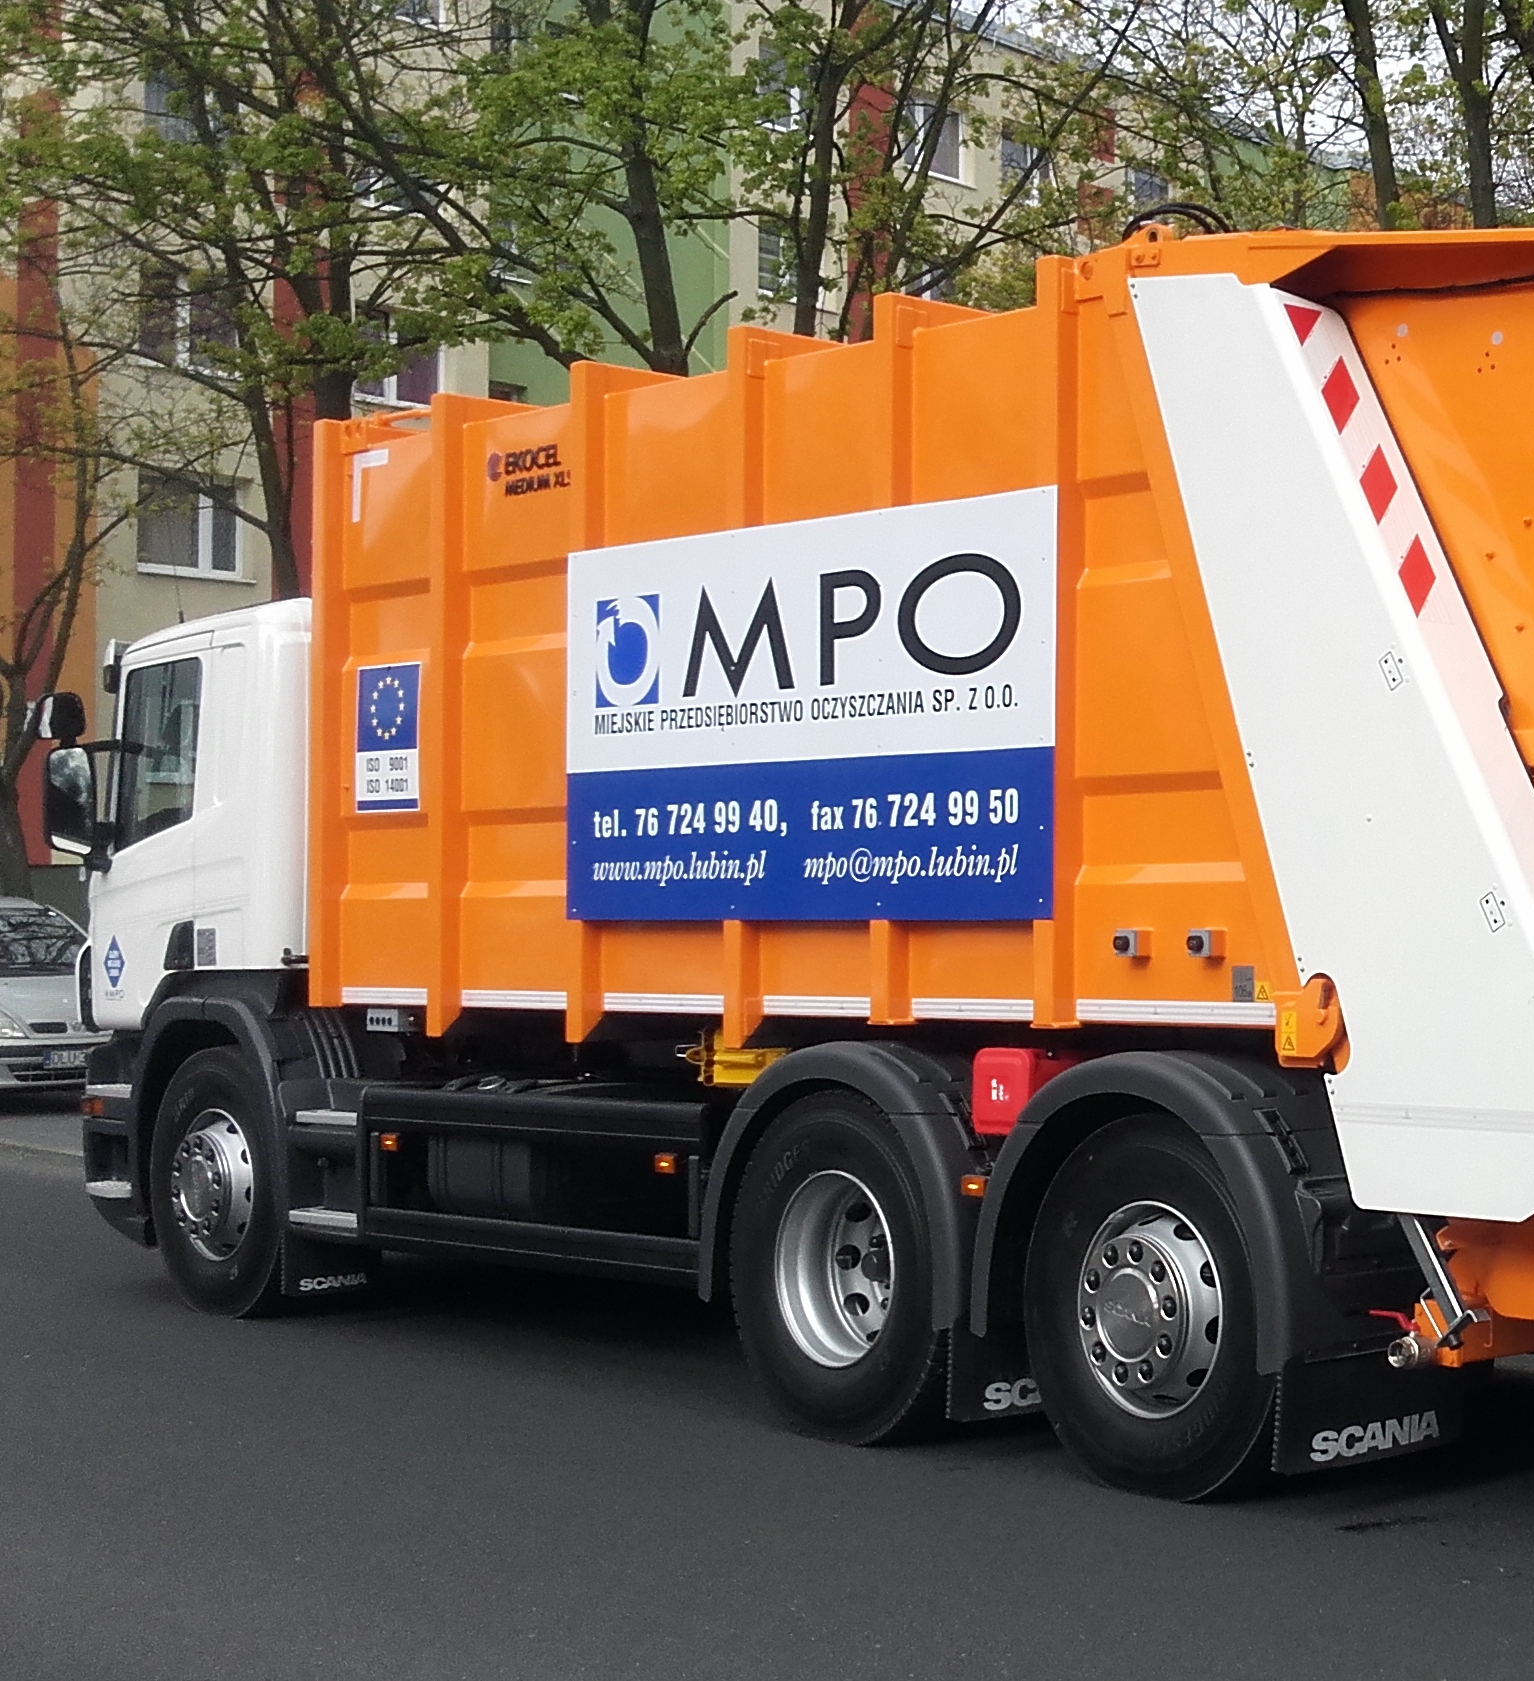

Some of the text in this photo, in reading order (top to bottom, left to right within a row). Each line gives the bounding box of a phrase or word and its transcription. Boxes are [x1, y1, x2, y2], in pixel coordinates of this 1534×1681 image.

[504, 444, 561, 475] EKOCEL
[682, 552, 1022, 699] MPO
[594, 684, 1018, 735] MIEJSKIE PRZEDSIĘBIORSTWO OCZYSZCZANIA SP. Z O.O.
[366, 757, 381, 772] ISO
[366, 778, 381, 794] ISO
[593, 787, 1019, 838] tel. 76 724 99 40, fax 76 724 99 50
[593, 843, 1020, 887] www.mpo.lubin.pl mpo@mpo.lubin.pl
[299, 1272, 367, 1291] SCANIA
[983, 1377, 1042, 1411] SC
[1309, 1410, 1440, 1462] SCANIA
